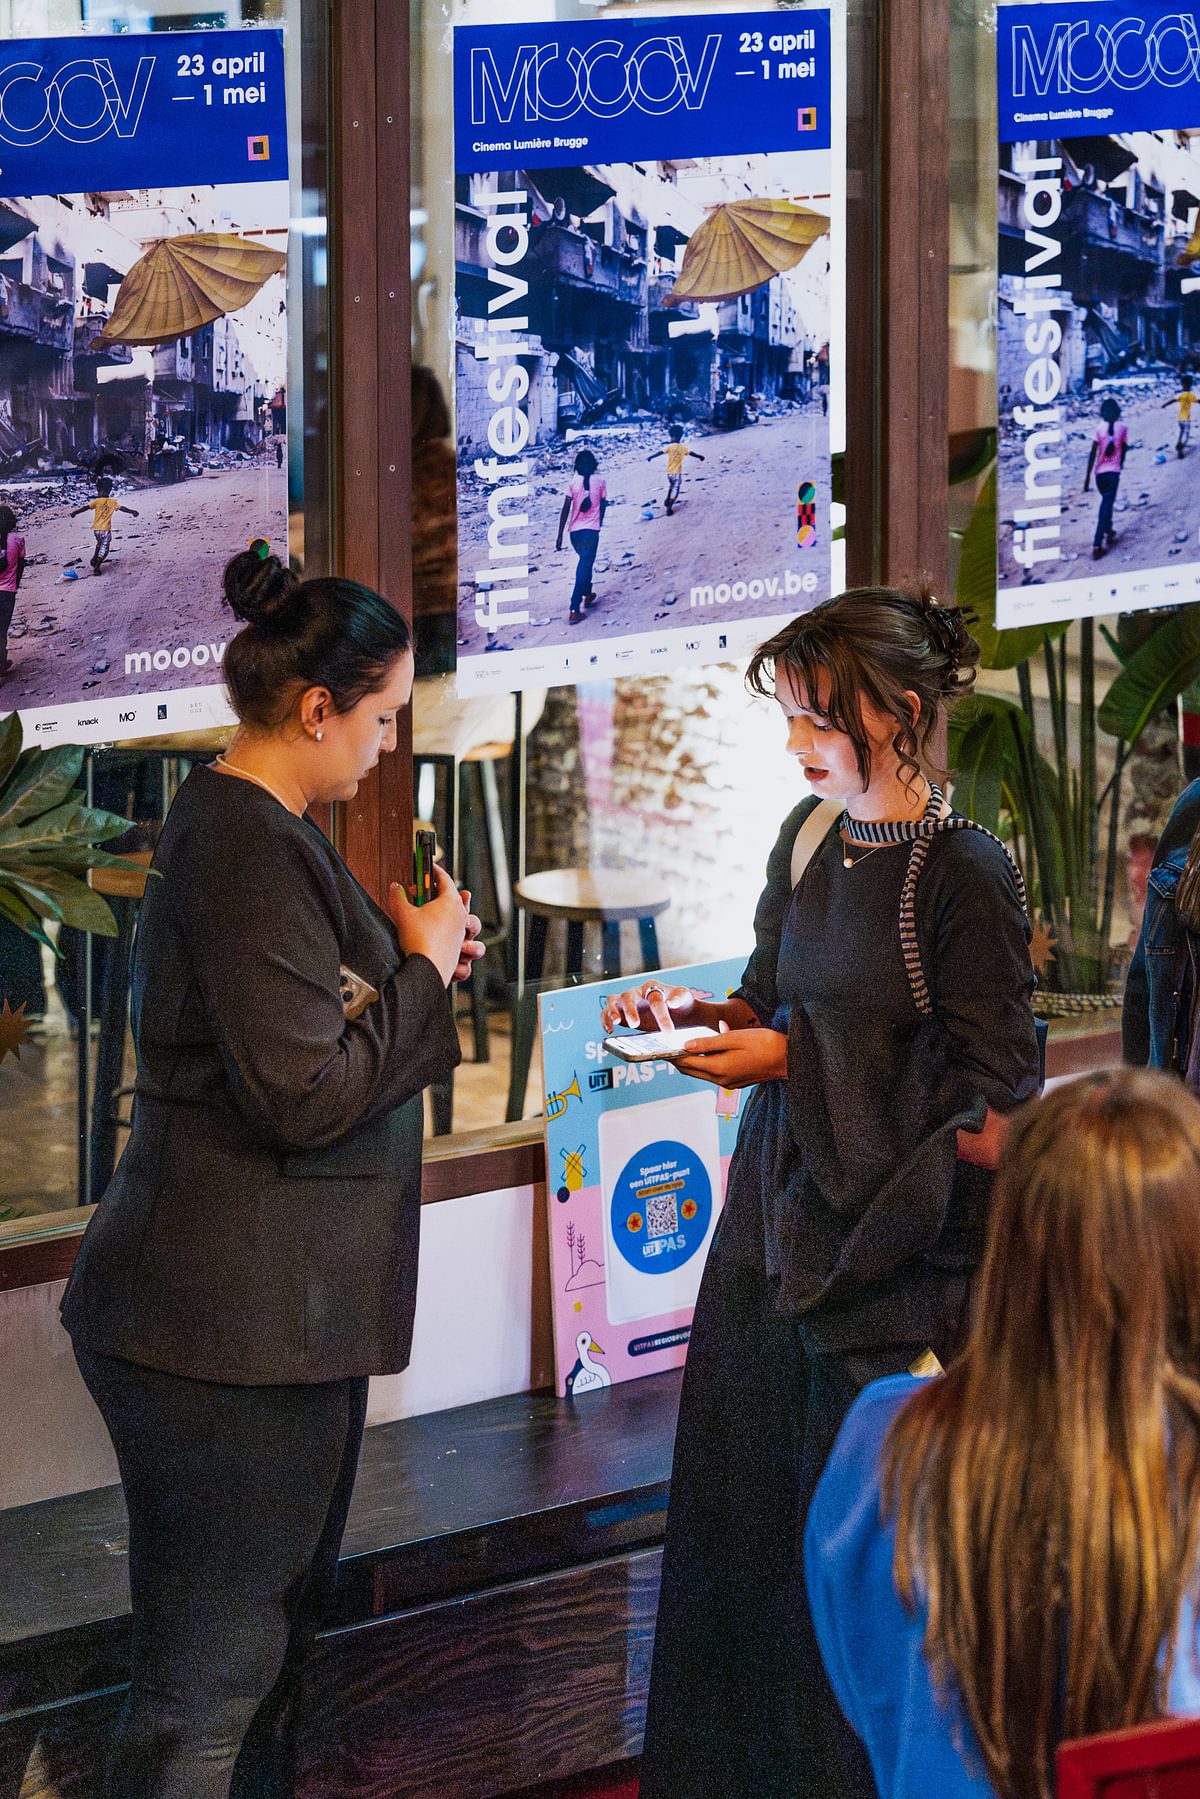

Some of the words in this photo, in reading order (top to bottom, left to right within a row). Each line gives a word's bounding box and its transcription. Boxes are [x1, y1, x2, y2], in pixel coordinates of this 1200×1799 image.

[738, 32, 764, 53] 23
[768, 29, 816, 55] april
[177, 54, 204, 77] 23
[212, 52, 265, 78] april
[762, 59, 770, 80] 1
[778, 57, 816, 79] mei
[471, 34, 722, 124] MOOOV
[0, 57, 156, 146] OOV
[203, 84, 213, 105] 1
[223, 82, 266, 105] mei
[472, 141, 511, 152] Cinema
[513, 138, 552, 150] Lumière
[553, 137, 589, 149] Brugge
[1013, 157, 1062, 569] filmfestival
[474, 190, 529, 633] filmfestival
[690, 570, 818, 607] mooov.be
[124, 642, 227, 675] mooov
[77, 717, 99, 727] knack
[584, 1041, 609, 1063] Sp
